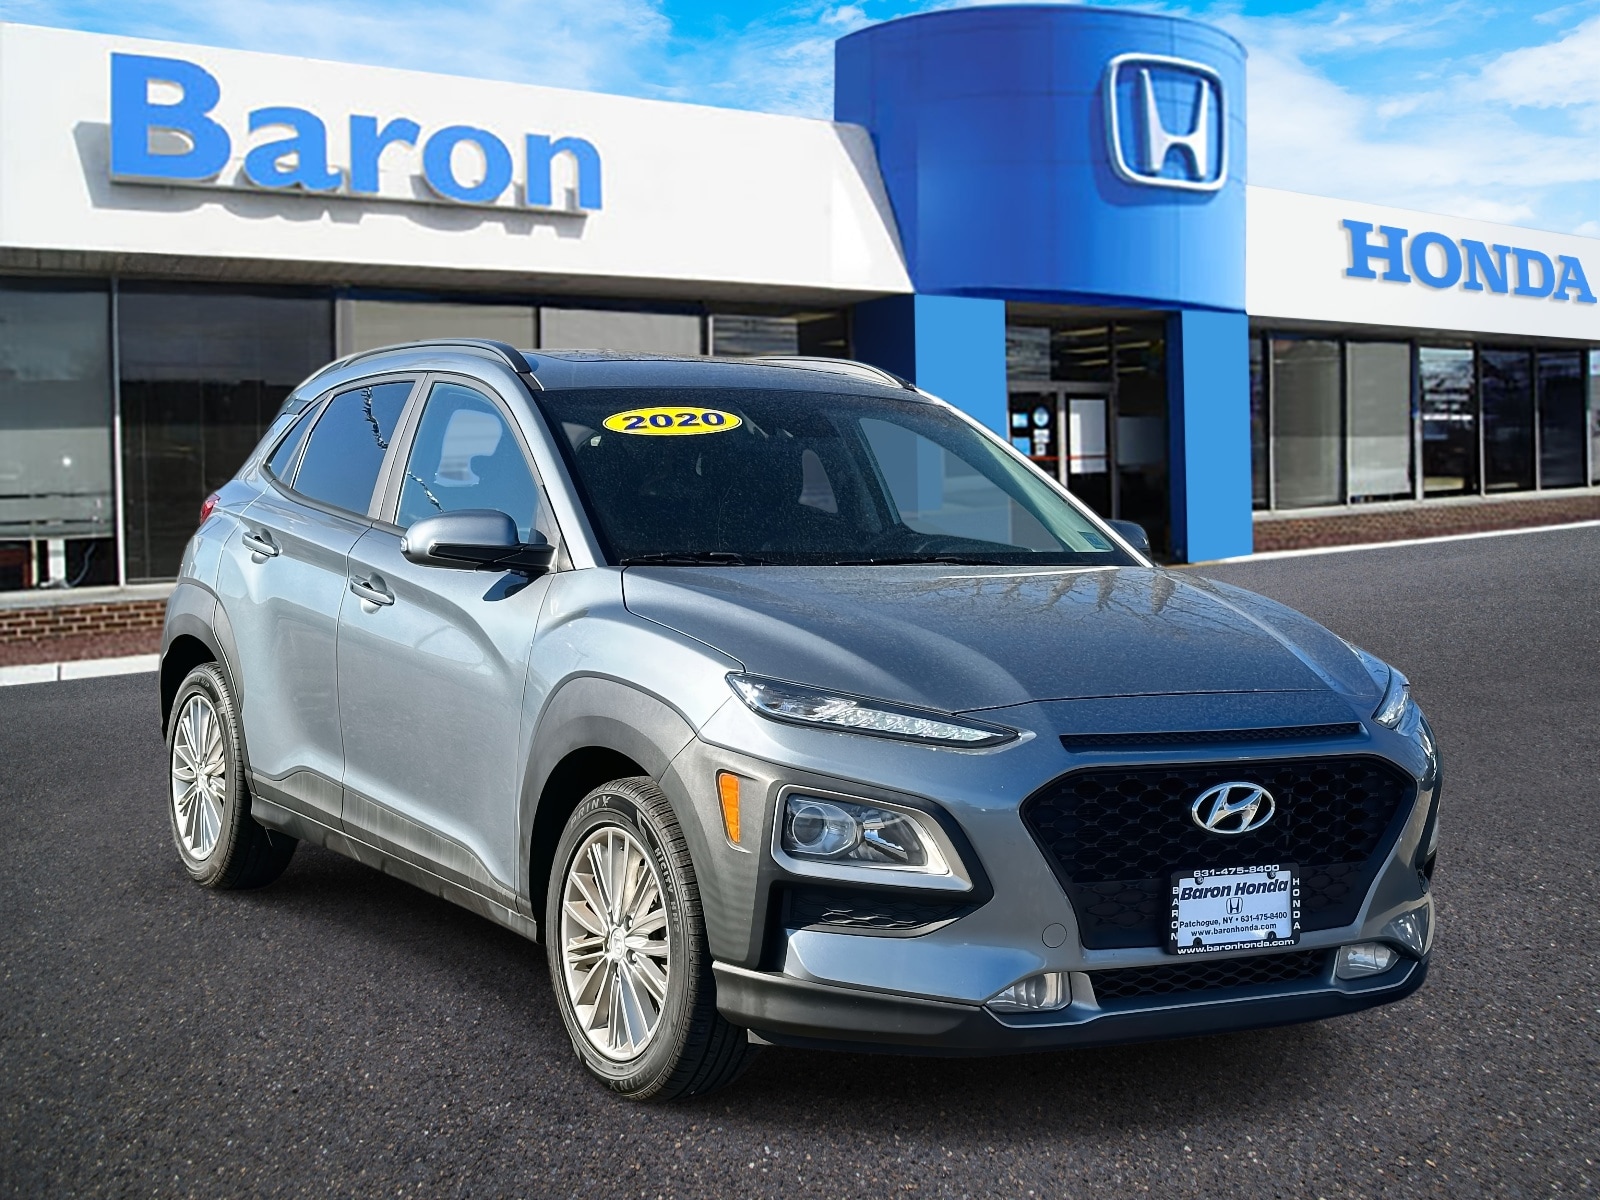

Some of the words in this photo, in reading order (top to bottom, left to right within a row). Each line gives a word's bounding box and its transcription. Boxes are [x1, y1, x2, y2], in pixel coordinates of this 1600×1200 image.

[110, 51, 603, 210] Baron
[1342, 218, 1598, 305] HONDA
[622, 412, 727, 431] 2020
[1193, 864, 1280, 878] 631-475-8400
[1180, 884, 1231, 901] Baron
[1234, 878, 1289, 896] Honda
[1170, 886, 1179, 941] BARON
[1292, 877, 1301, 930] HONDA
[1179, 918, 1221, 929] Patchogue,
[1222, 916, 1234, 925] NY
[1240, 911, 1288, 923] 631-475-8400
[1190, 922, 1277, 937] www.baronhonda.com
[1177, 938, 1295, 955] www.baronhonda.com
